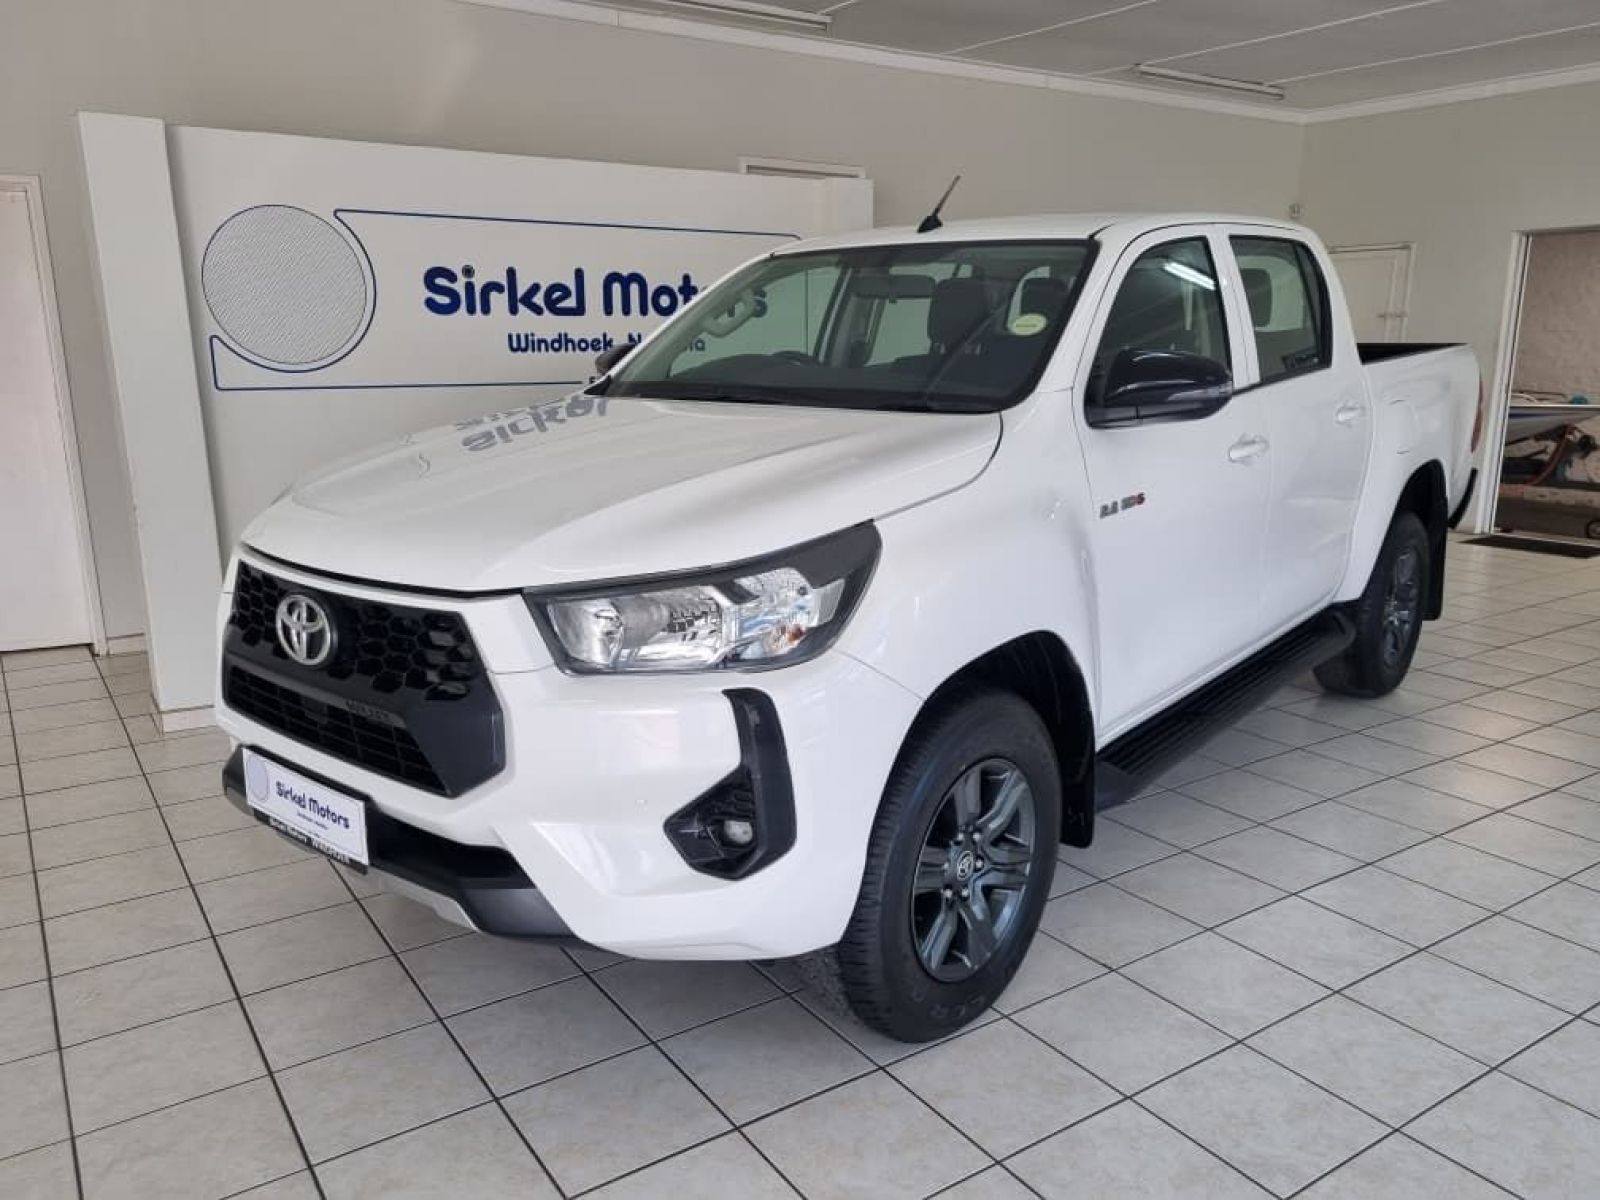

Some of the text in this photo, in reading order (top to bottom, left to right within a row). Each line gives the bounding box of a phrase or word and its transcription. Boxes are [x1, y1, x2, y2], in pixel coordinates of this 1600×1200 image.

[423, 265, 768, 318] Sirkel Mots
[507, 332, 613, 353] Windhoek
[275, 780, 307, 809] Sirkel
[308, 797, 350, 829] Motors
